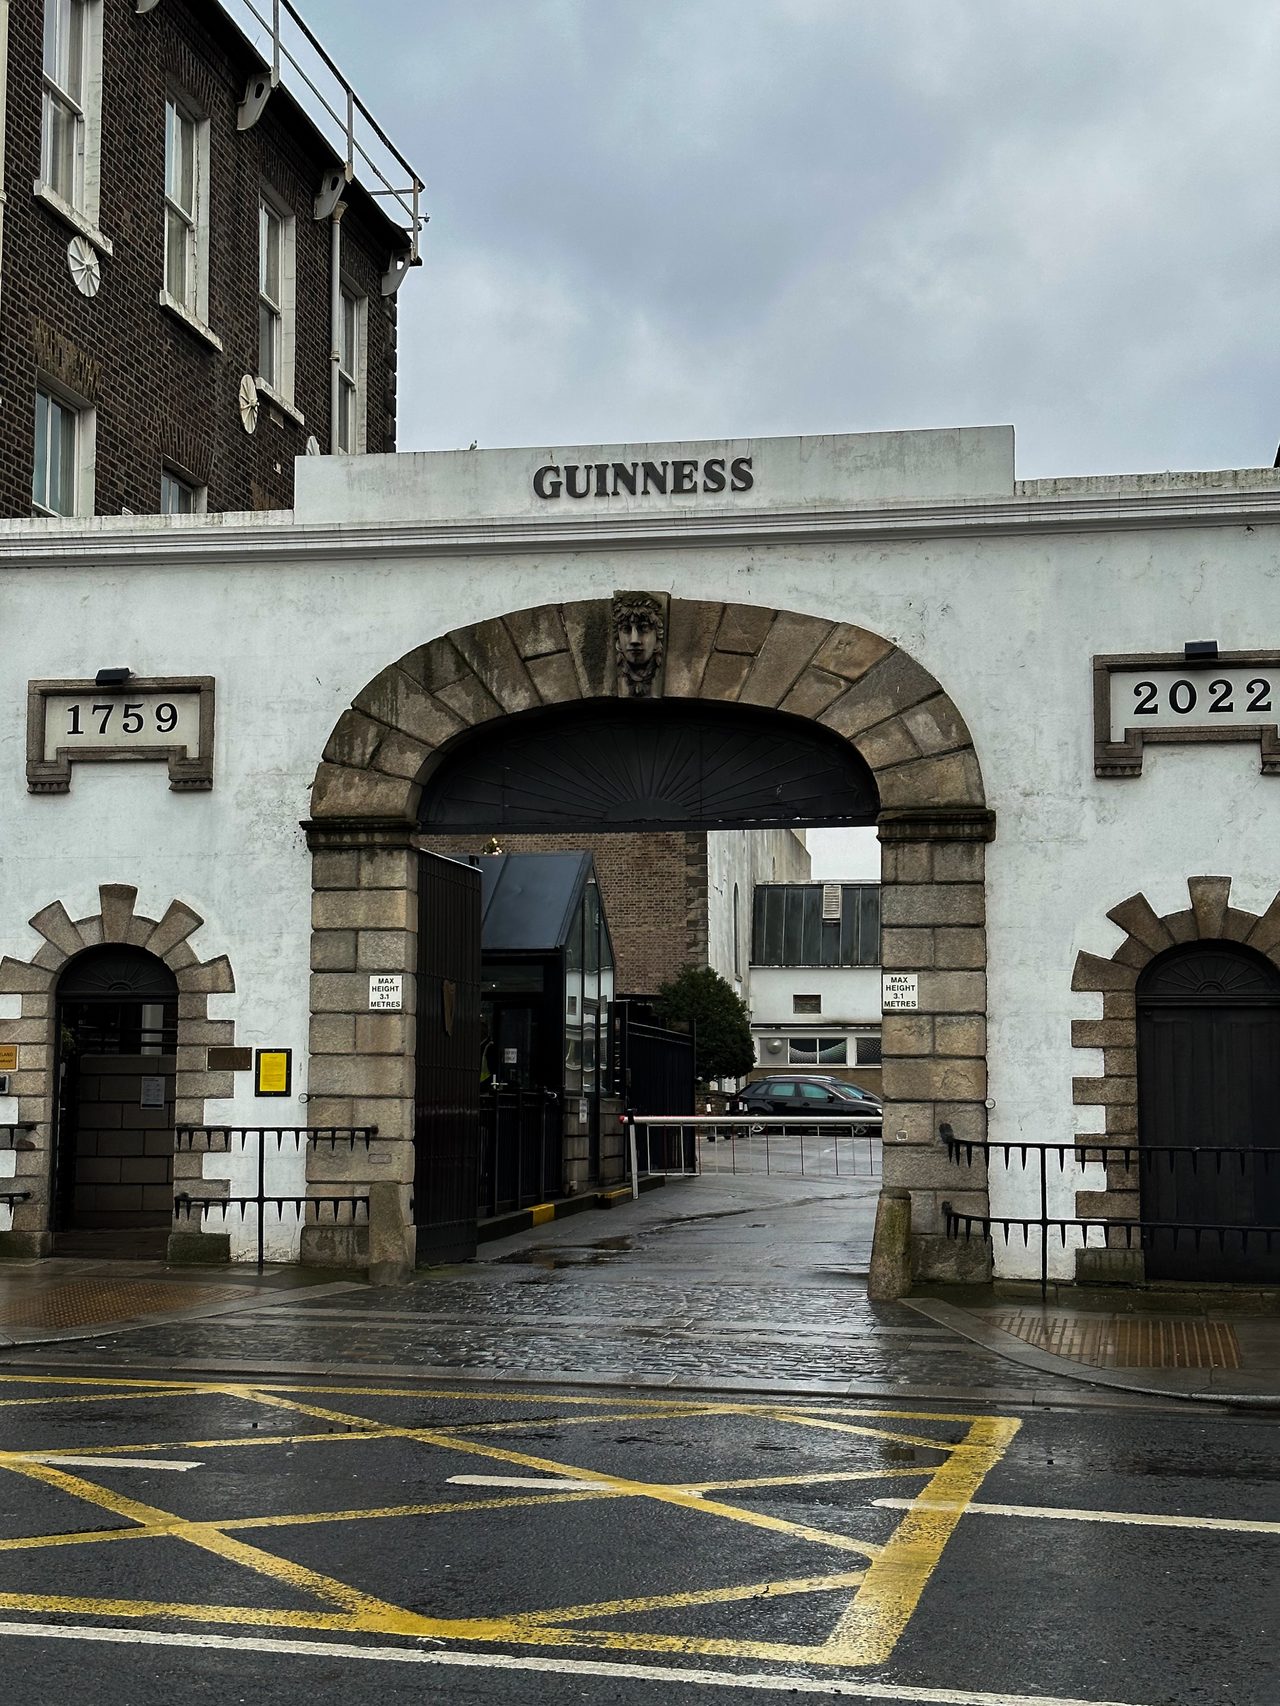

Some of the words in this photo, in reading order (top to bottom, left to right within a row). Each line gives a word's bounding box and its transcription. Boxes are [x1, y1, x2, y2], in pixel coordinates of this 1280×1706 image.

[533, 457, 754, 499] GUINNESS
[1133, 678, 1272, 715] 2022
[67, 702, 178, 735] 1759
[885, 984, 916, 992] HEIGHT
[893, 992, 904, 1000] 3.1
[884, 1000, 917, 1008] METRES
